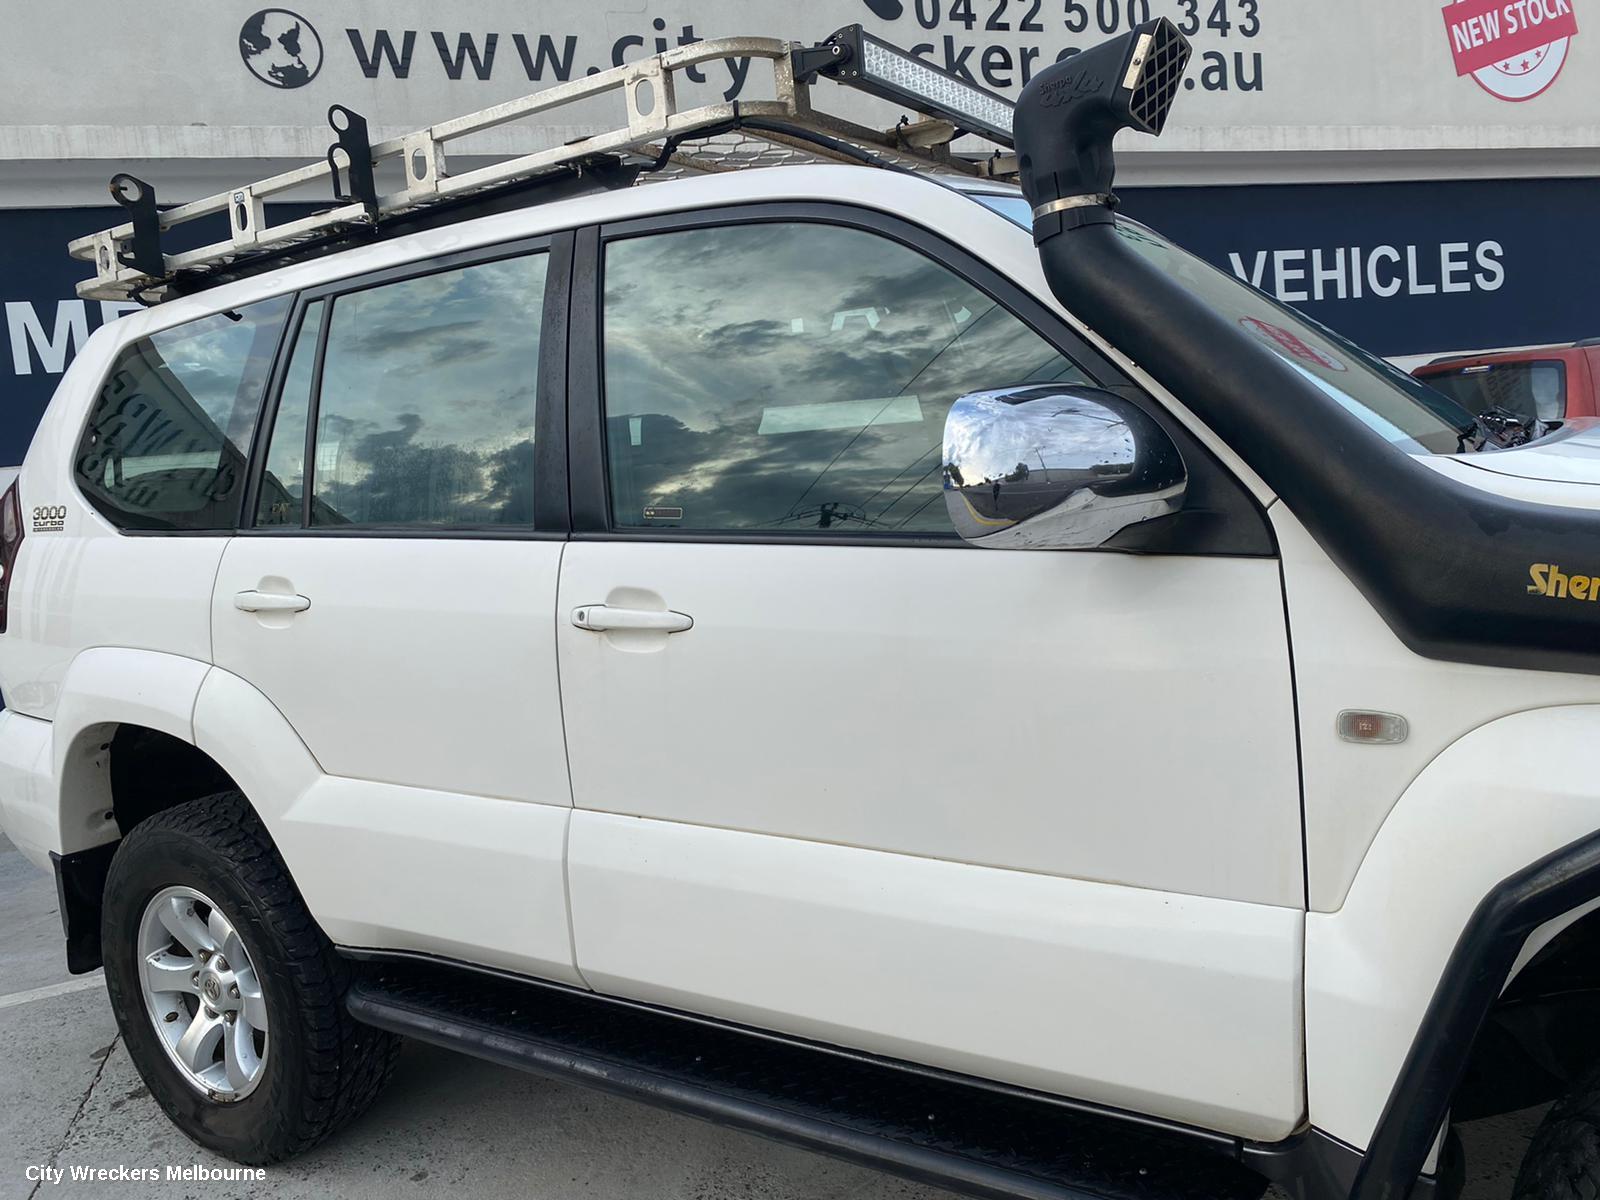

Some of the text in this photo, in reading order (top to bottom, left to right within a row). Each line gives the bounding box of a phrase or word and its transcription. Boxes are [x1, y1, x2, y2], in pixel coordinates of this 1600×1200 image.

[914, 0, 1044, 31] 0422
[1177, 0, 1260, 37] 343
[1452, 9, 1500, 53] NEW
[1228, 240, 1506, 302] VEHICLES
[33, 505, 67, 520] 3000
